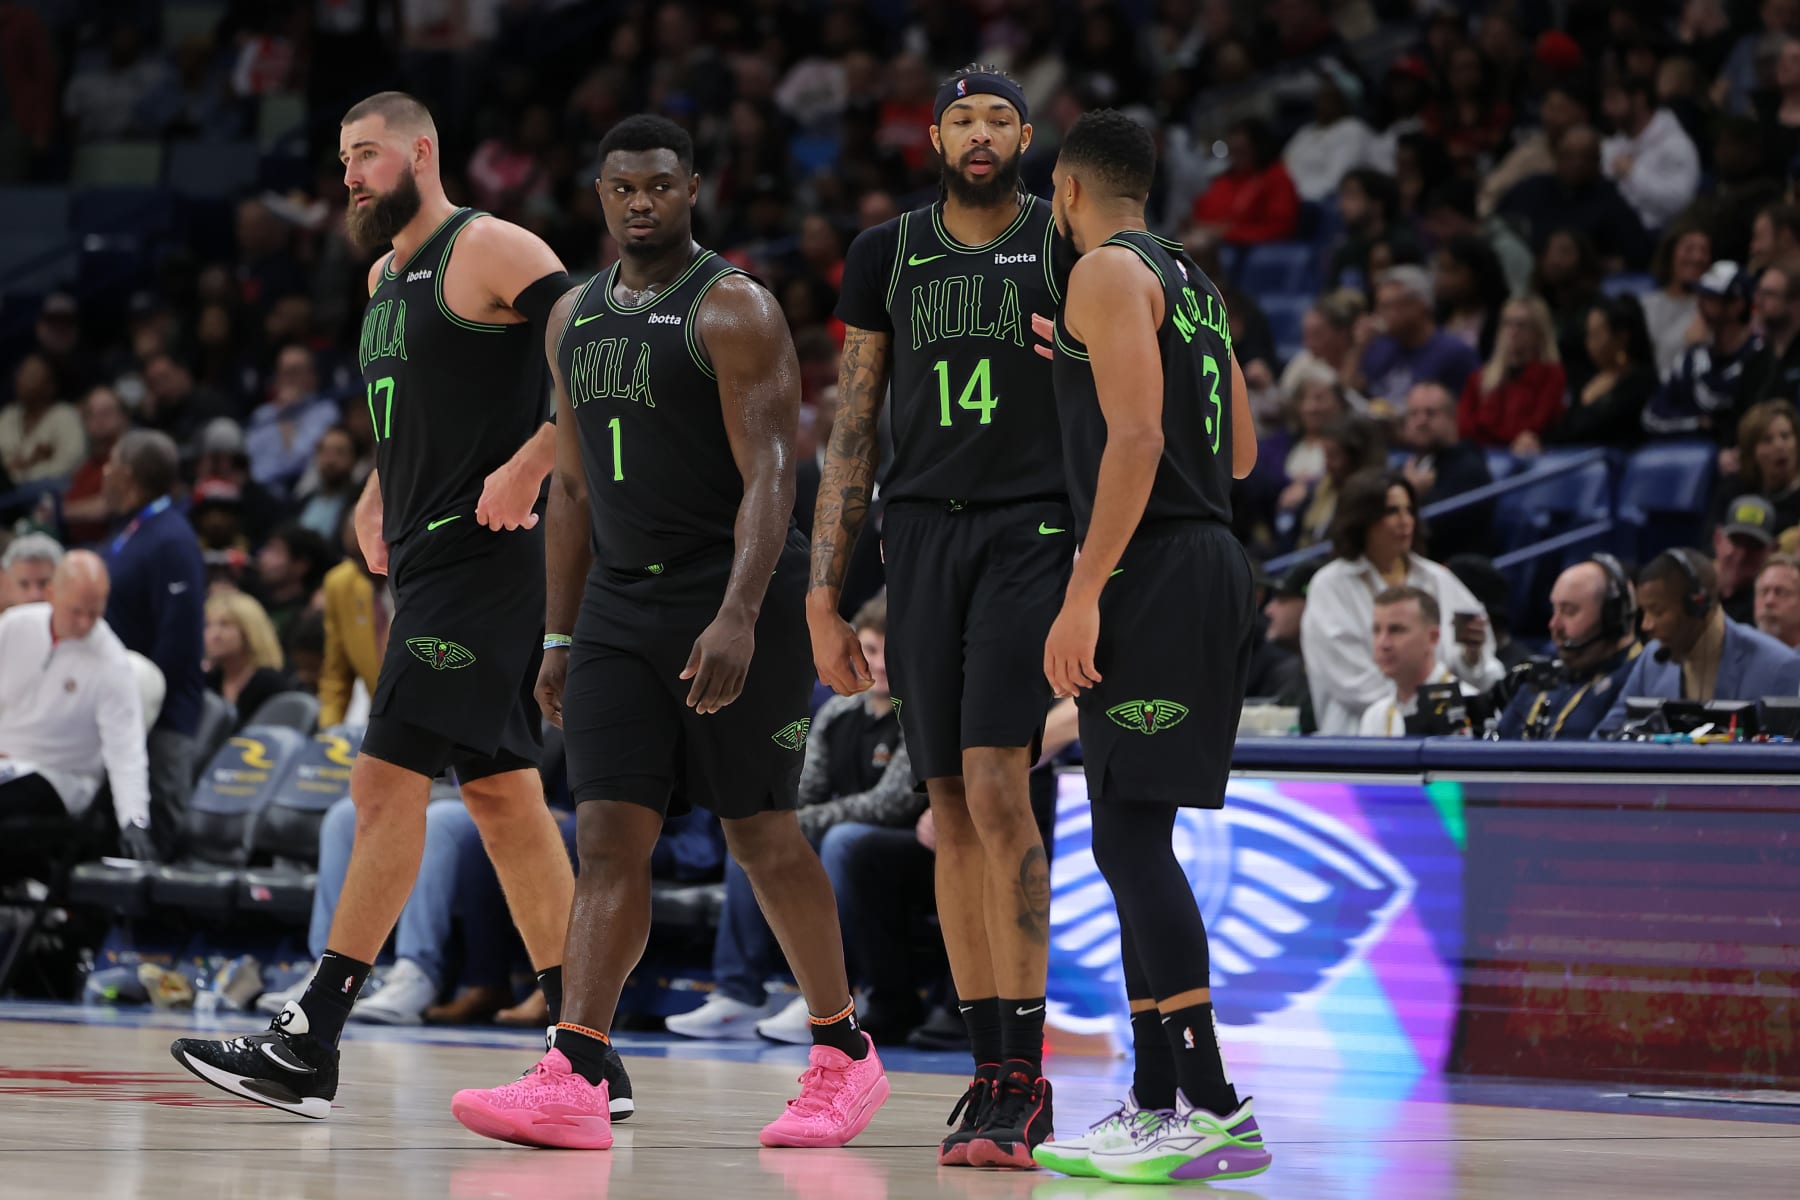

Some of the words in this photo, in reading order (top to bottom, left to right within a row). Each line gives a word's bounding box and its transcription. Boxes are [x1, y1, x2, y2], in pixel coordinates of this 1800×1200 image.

[407, 269, 432, 282] ibotta
[994, 253, 1037, 265] ibotta
[359, 299, 408, 375] NOLA
[648, 312, 682, 325] ibotta
[910, 275, 1025, 350] NOLA
[570, 337, 656, 409] NOLA
[933, 358, 999, 427] 14
[1203, 355, 1222, 455] 3
[367, 376, 396, 443] 17
[608, 417, 624, 481] 1
